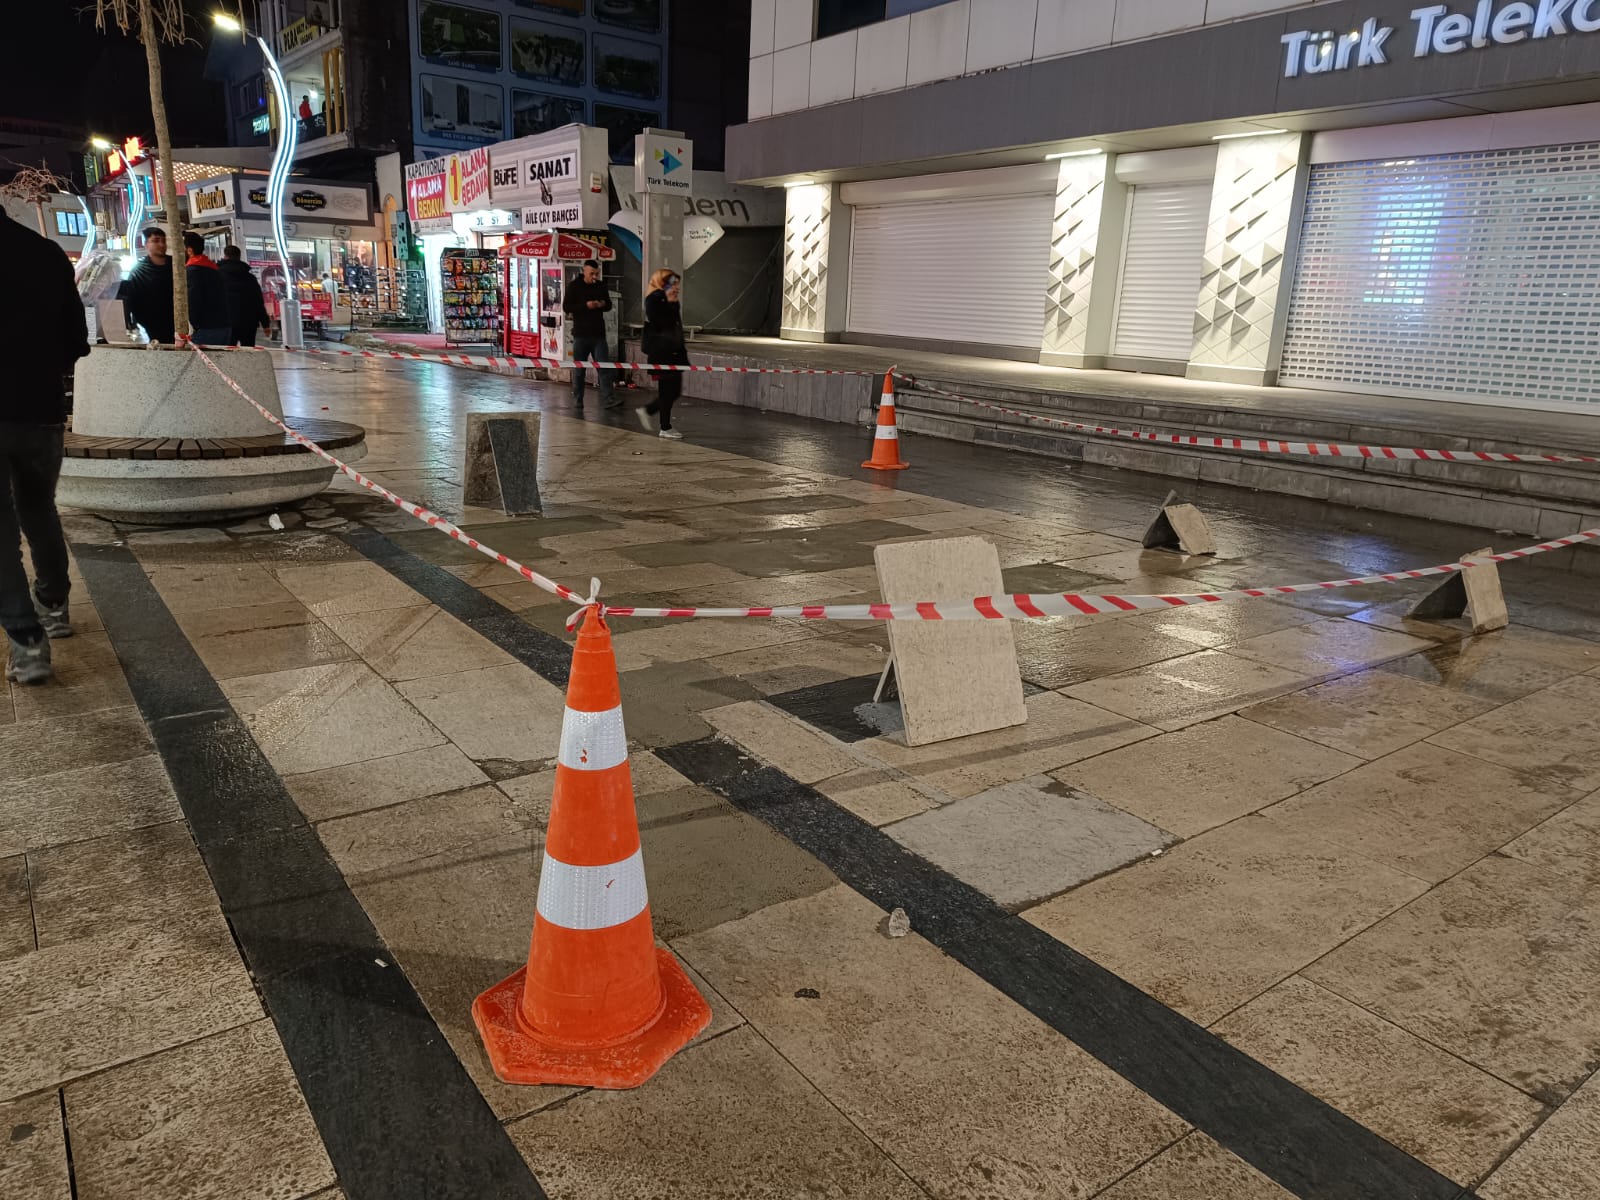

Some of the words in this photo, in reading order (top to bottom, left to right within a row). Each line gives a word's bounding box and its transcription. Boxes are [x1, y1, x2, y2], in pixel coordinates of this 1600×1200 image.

[1280, 16, 1393, 78] Türk
[408, 158, 446, 179] KAPATIYORUZ
[450, 159, 459, 201] 1
[461, 147, 487, 180] ALANA
[494, 167, 517, 186] BÜFE
[530, 157, 571, 181] SANAT
[418, 176, 442, 198] ALANA
[461, 169, 488, 206] BEDAVA
[648, 177, 661, 185] Türk
[663, 179, 689, 188] Telekom
[418, 197, 446, 218] BEDAVA
[525, 210, 538, 225] AİLE
[539, 211, 550, 228] ÇAY
[552, 204, 579, 225] BAHÇESİ
